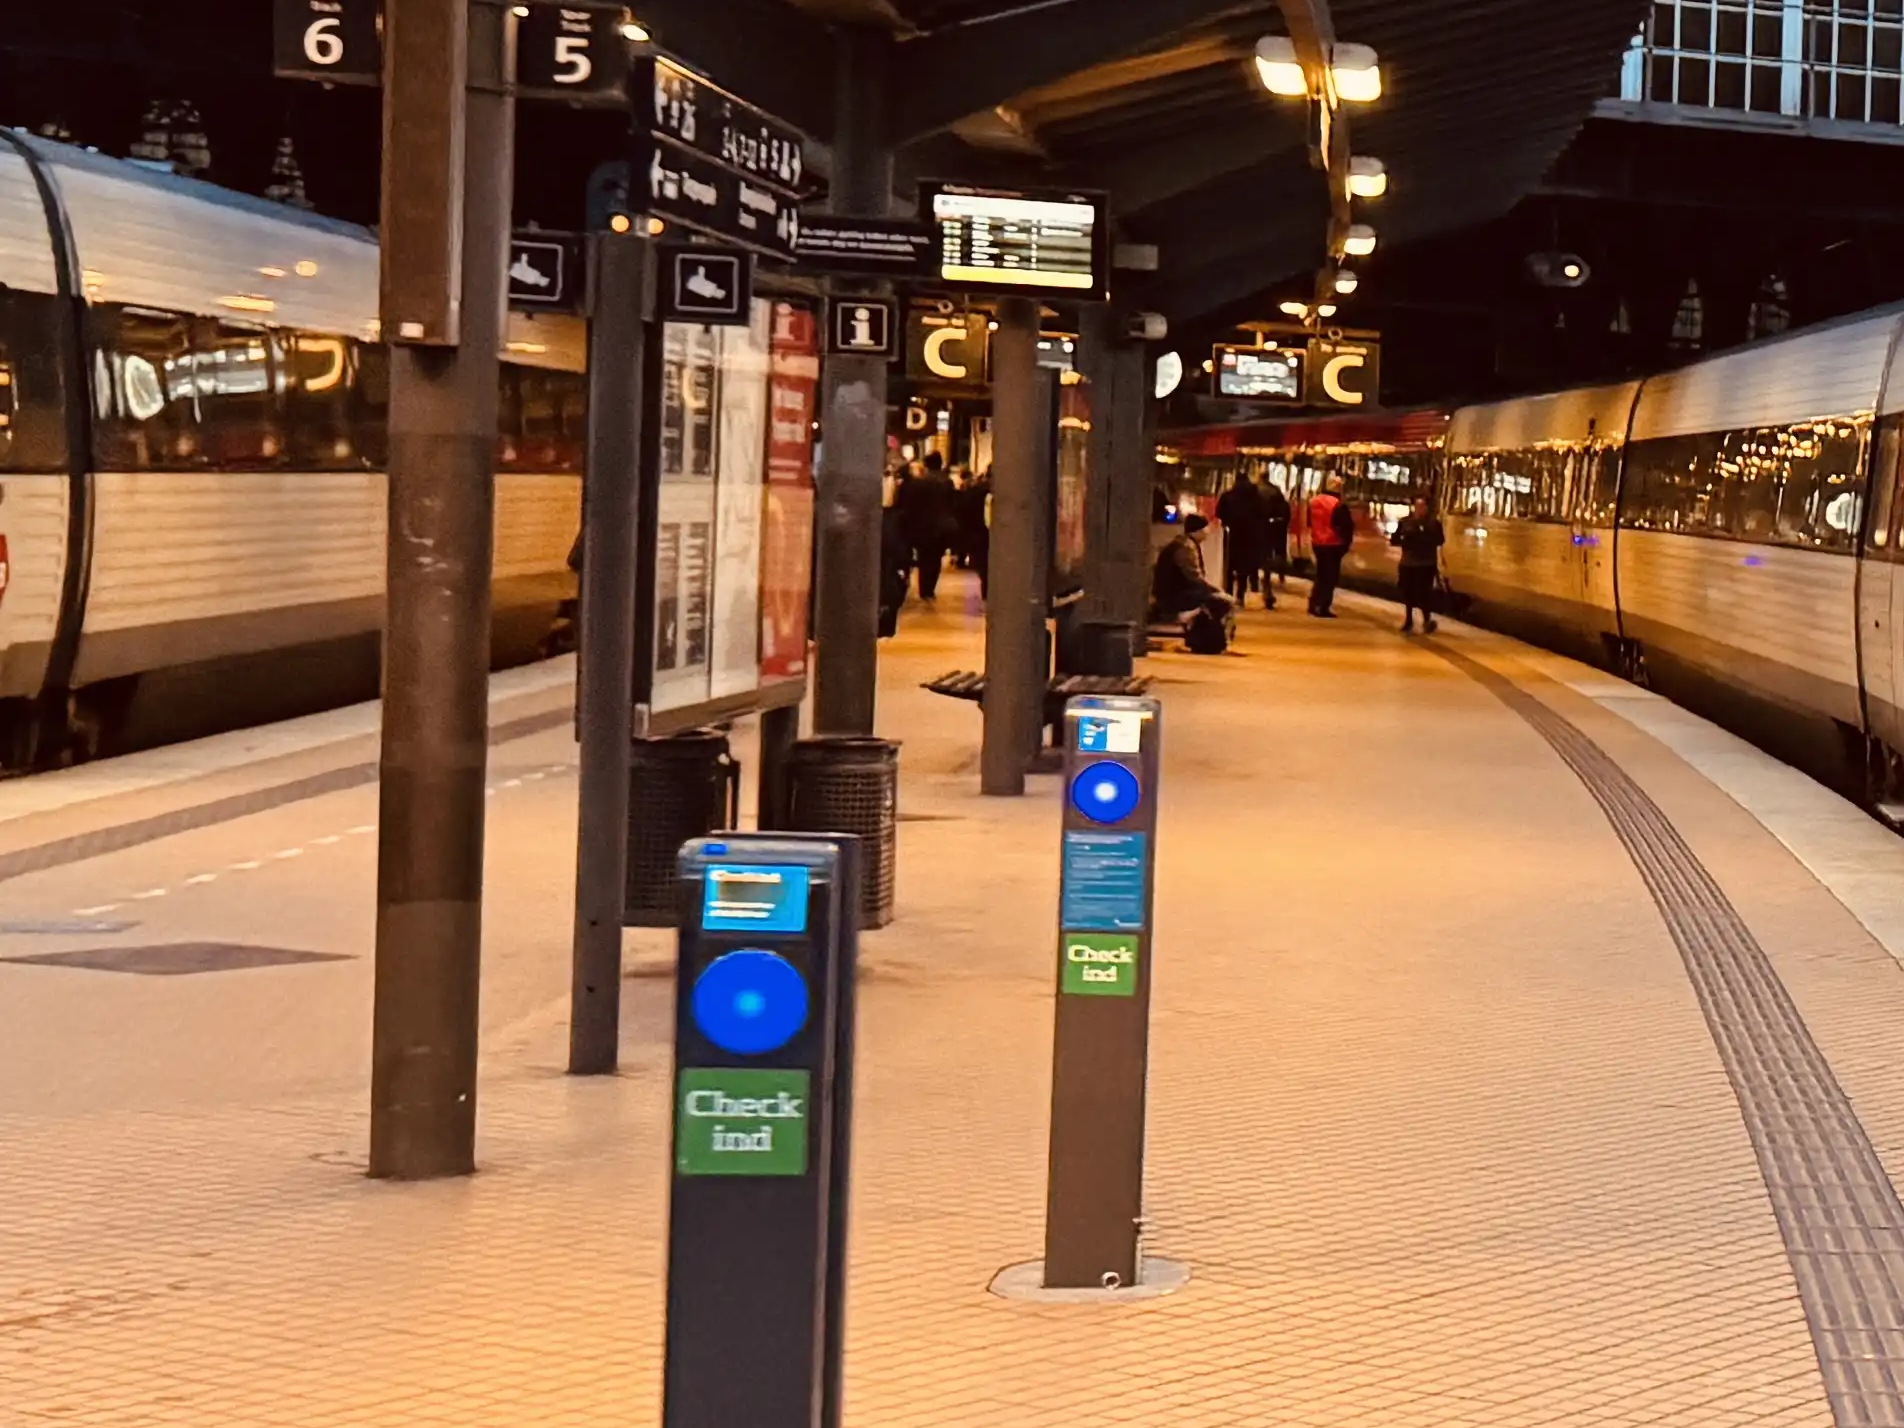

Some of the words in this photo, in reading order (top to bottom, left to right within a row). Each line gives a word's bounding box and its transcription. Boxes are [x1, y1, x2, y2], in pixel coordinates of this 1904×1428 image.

[303, 17, 344, 65] 6
[552, 36, 592, 84] 5
[924, 327, 968, 379] C
[1322, 354, 1364, 404] C
[906, 406, 928, 431] D
[1067, 944, 1134, 964] Check
[1082, 965, 1118, 982] ind
[685, 1089, 804, 1118] Check
[711, 1124, 773, 1152] ind
